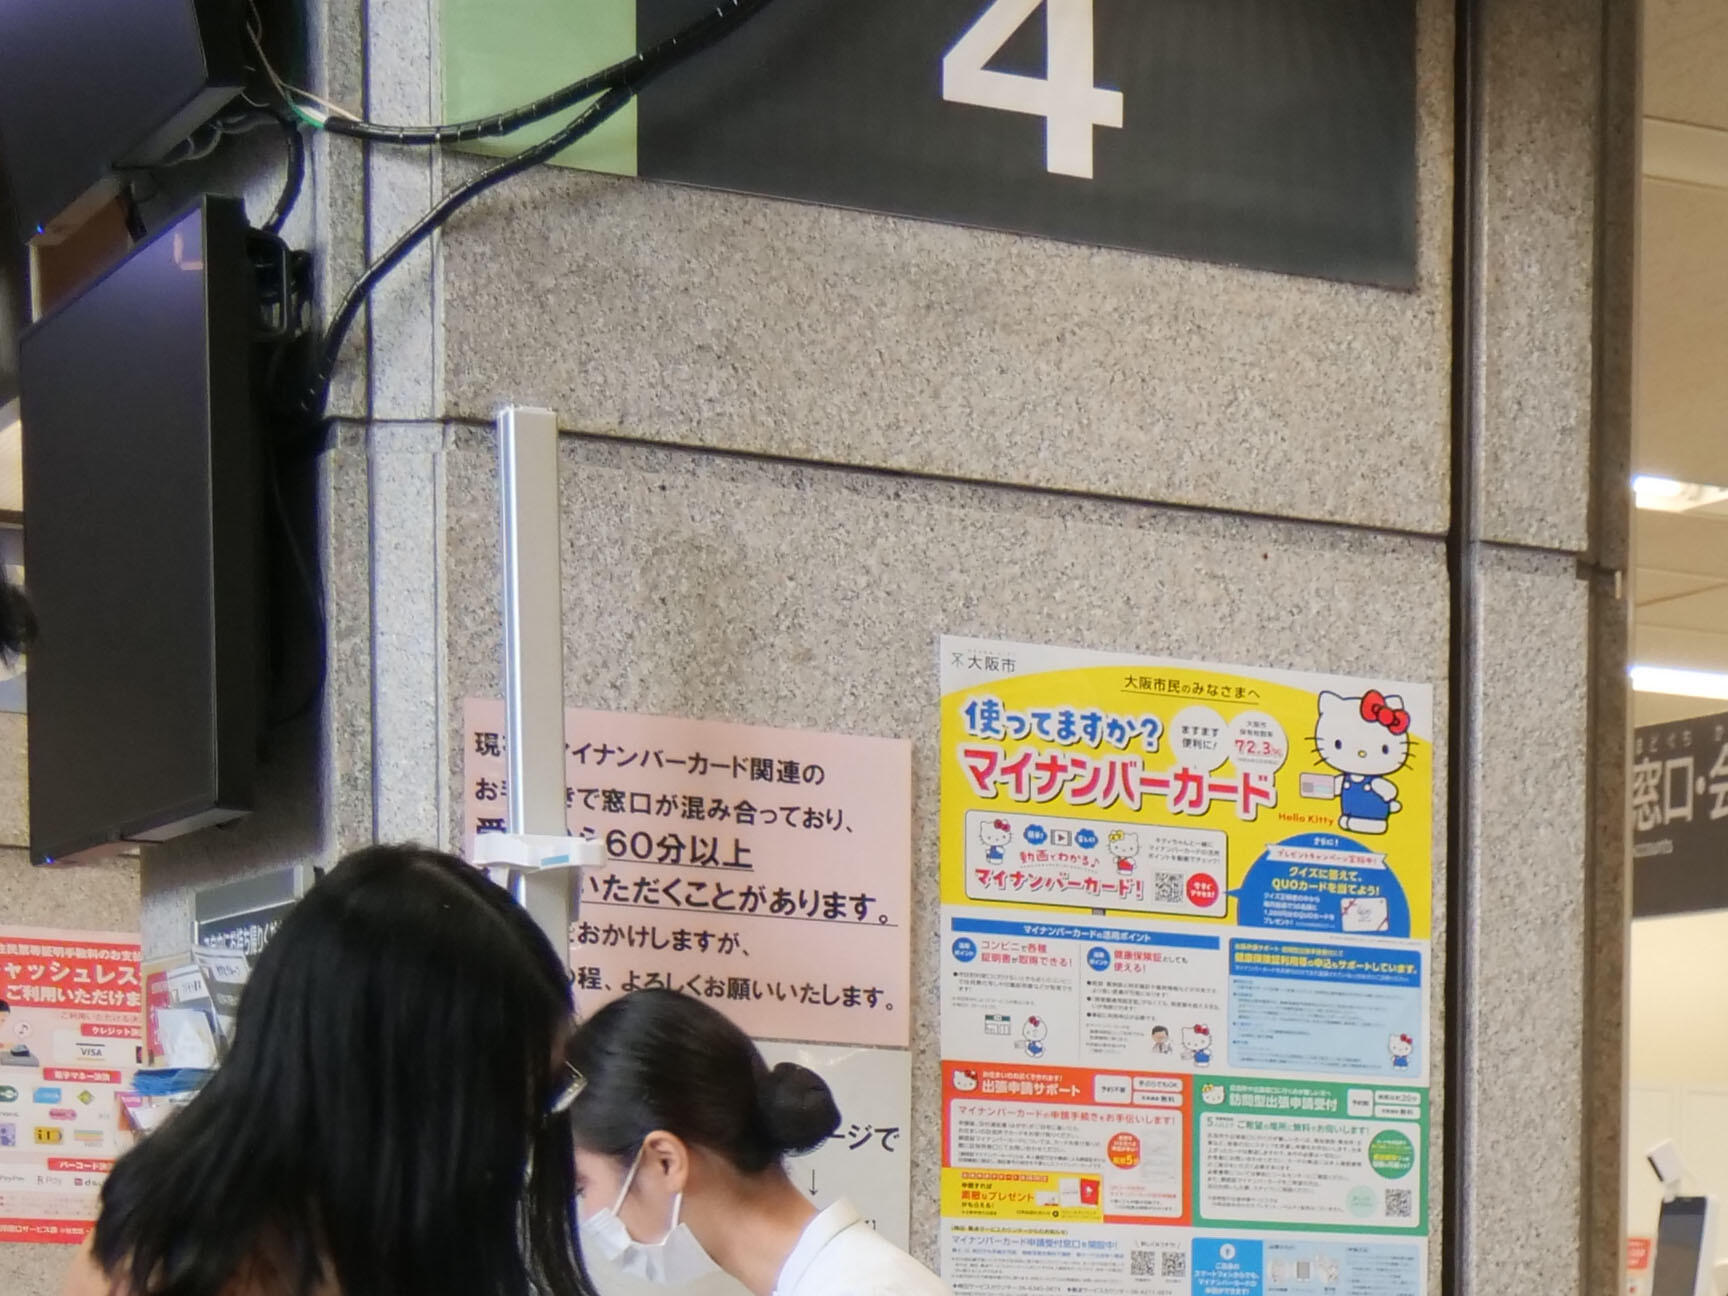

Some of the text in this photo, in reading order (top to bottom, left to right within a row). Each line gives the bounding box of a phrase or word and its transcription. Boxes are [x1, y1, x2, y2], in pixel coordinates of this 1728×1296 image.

[942, 0, 1123, 179] 4
[967, 656, 1017, 673] 大阪市
[1124, 674, 1260, 698] 大阪市民のみなさまへ
[964, 699, 1159, 747] 使ってますか?
[1181, 726, 1219, 737] ますます
[1182, 738, 1217, 750] 便利に!
[964, 749, 1270, 814] マイナンバーカード
[1278, 812, 1334, 826] Hello Kitty
[1289, 867, 1363, 882] クイズに答えて、
[975, 868, 1144, 900] マイナンバーカード!
[1272, 878, 1380, 896] QUOカードを当てよう!
[571, 921, 750, 957] おかけしますが、
[981, 940, 1047, 954] コンビニで各種
[981, 953, 1073, 968] 証明書が取得できる!
[1113, 962, 1146, 973] 使える!
[81, 1047, 103, 1057] VISA
